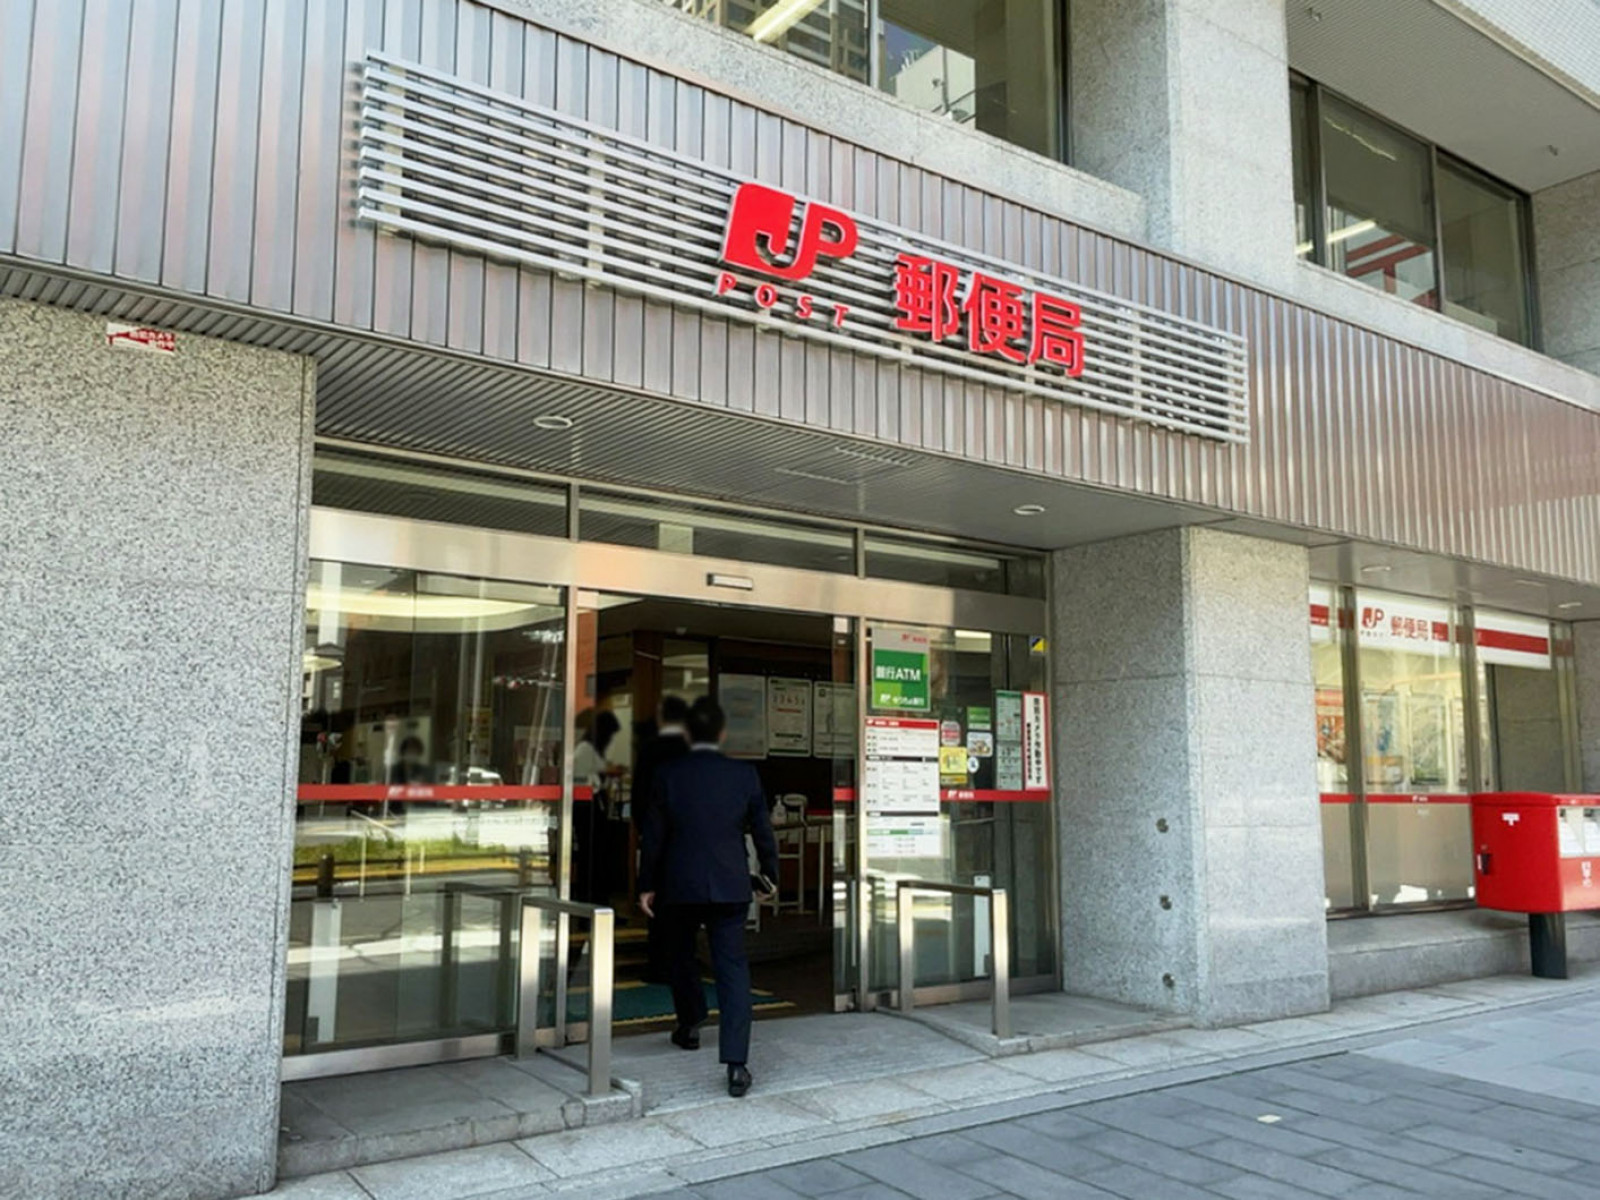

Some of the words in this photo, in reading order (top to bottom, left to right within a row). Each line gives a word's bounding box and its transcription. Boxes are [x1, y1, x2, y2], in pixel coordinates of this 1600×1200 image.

[722, 182, 858, 281] JP
[716, 273, 850, 328] POST
[894, 253, 1085, 378] 郵便局
[1390, 615, 1429, 641] 郵便局
